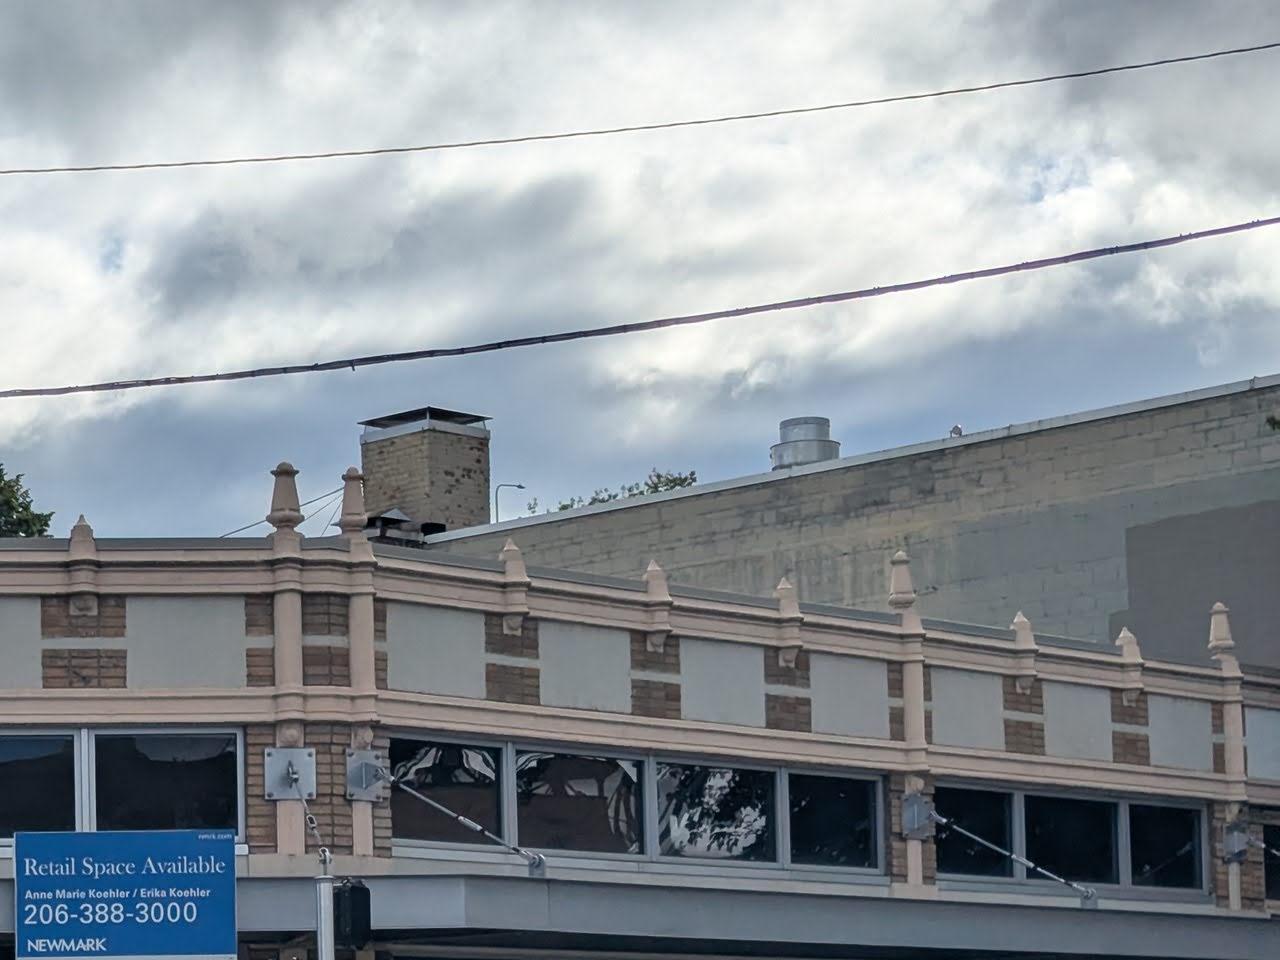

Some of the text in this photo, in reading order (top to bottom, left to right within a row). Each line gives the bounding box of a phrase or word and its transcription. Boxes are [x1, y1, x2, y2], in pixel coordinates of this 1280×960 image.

[24, 855, 226, 879] Retail Space Available
[24, 889, 53, 899] Anne
[55, 889, 86, 899] Marie
[88, 888, 130, 898] Koehler
[140, 888, 167, 898] Erika
[169, 887, 211, 897] Koehler
[24, 902, 197, 925] 206-388-3000
[27, 938, 107, 952] NEWMARK
